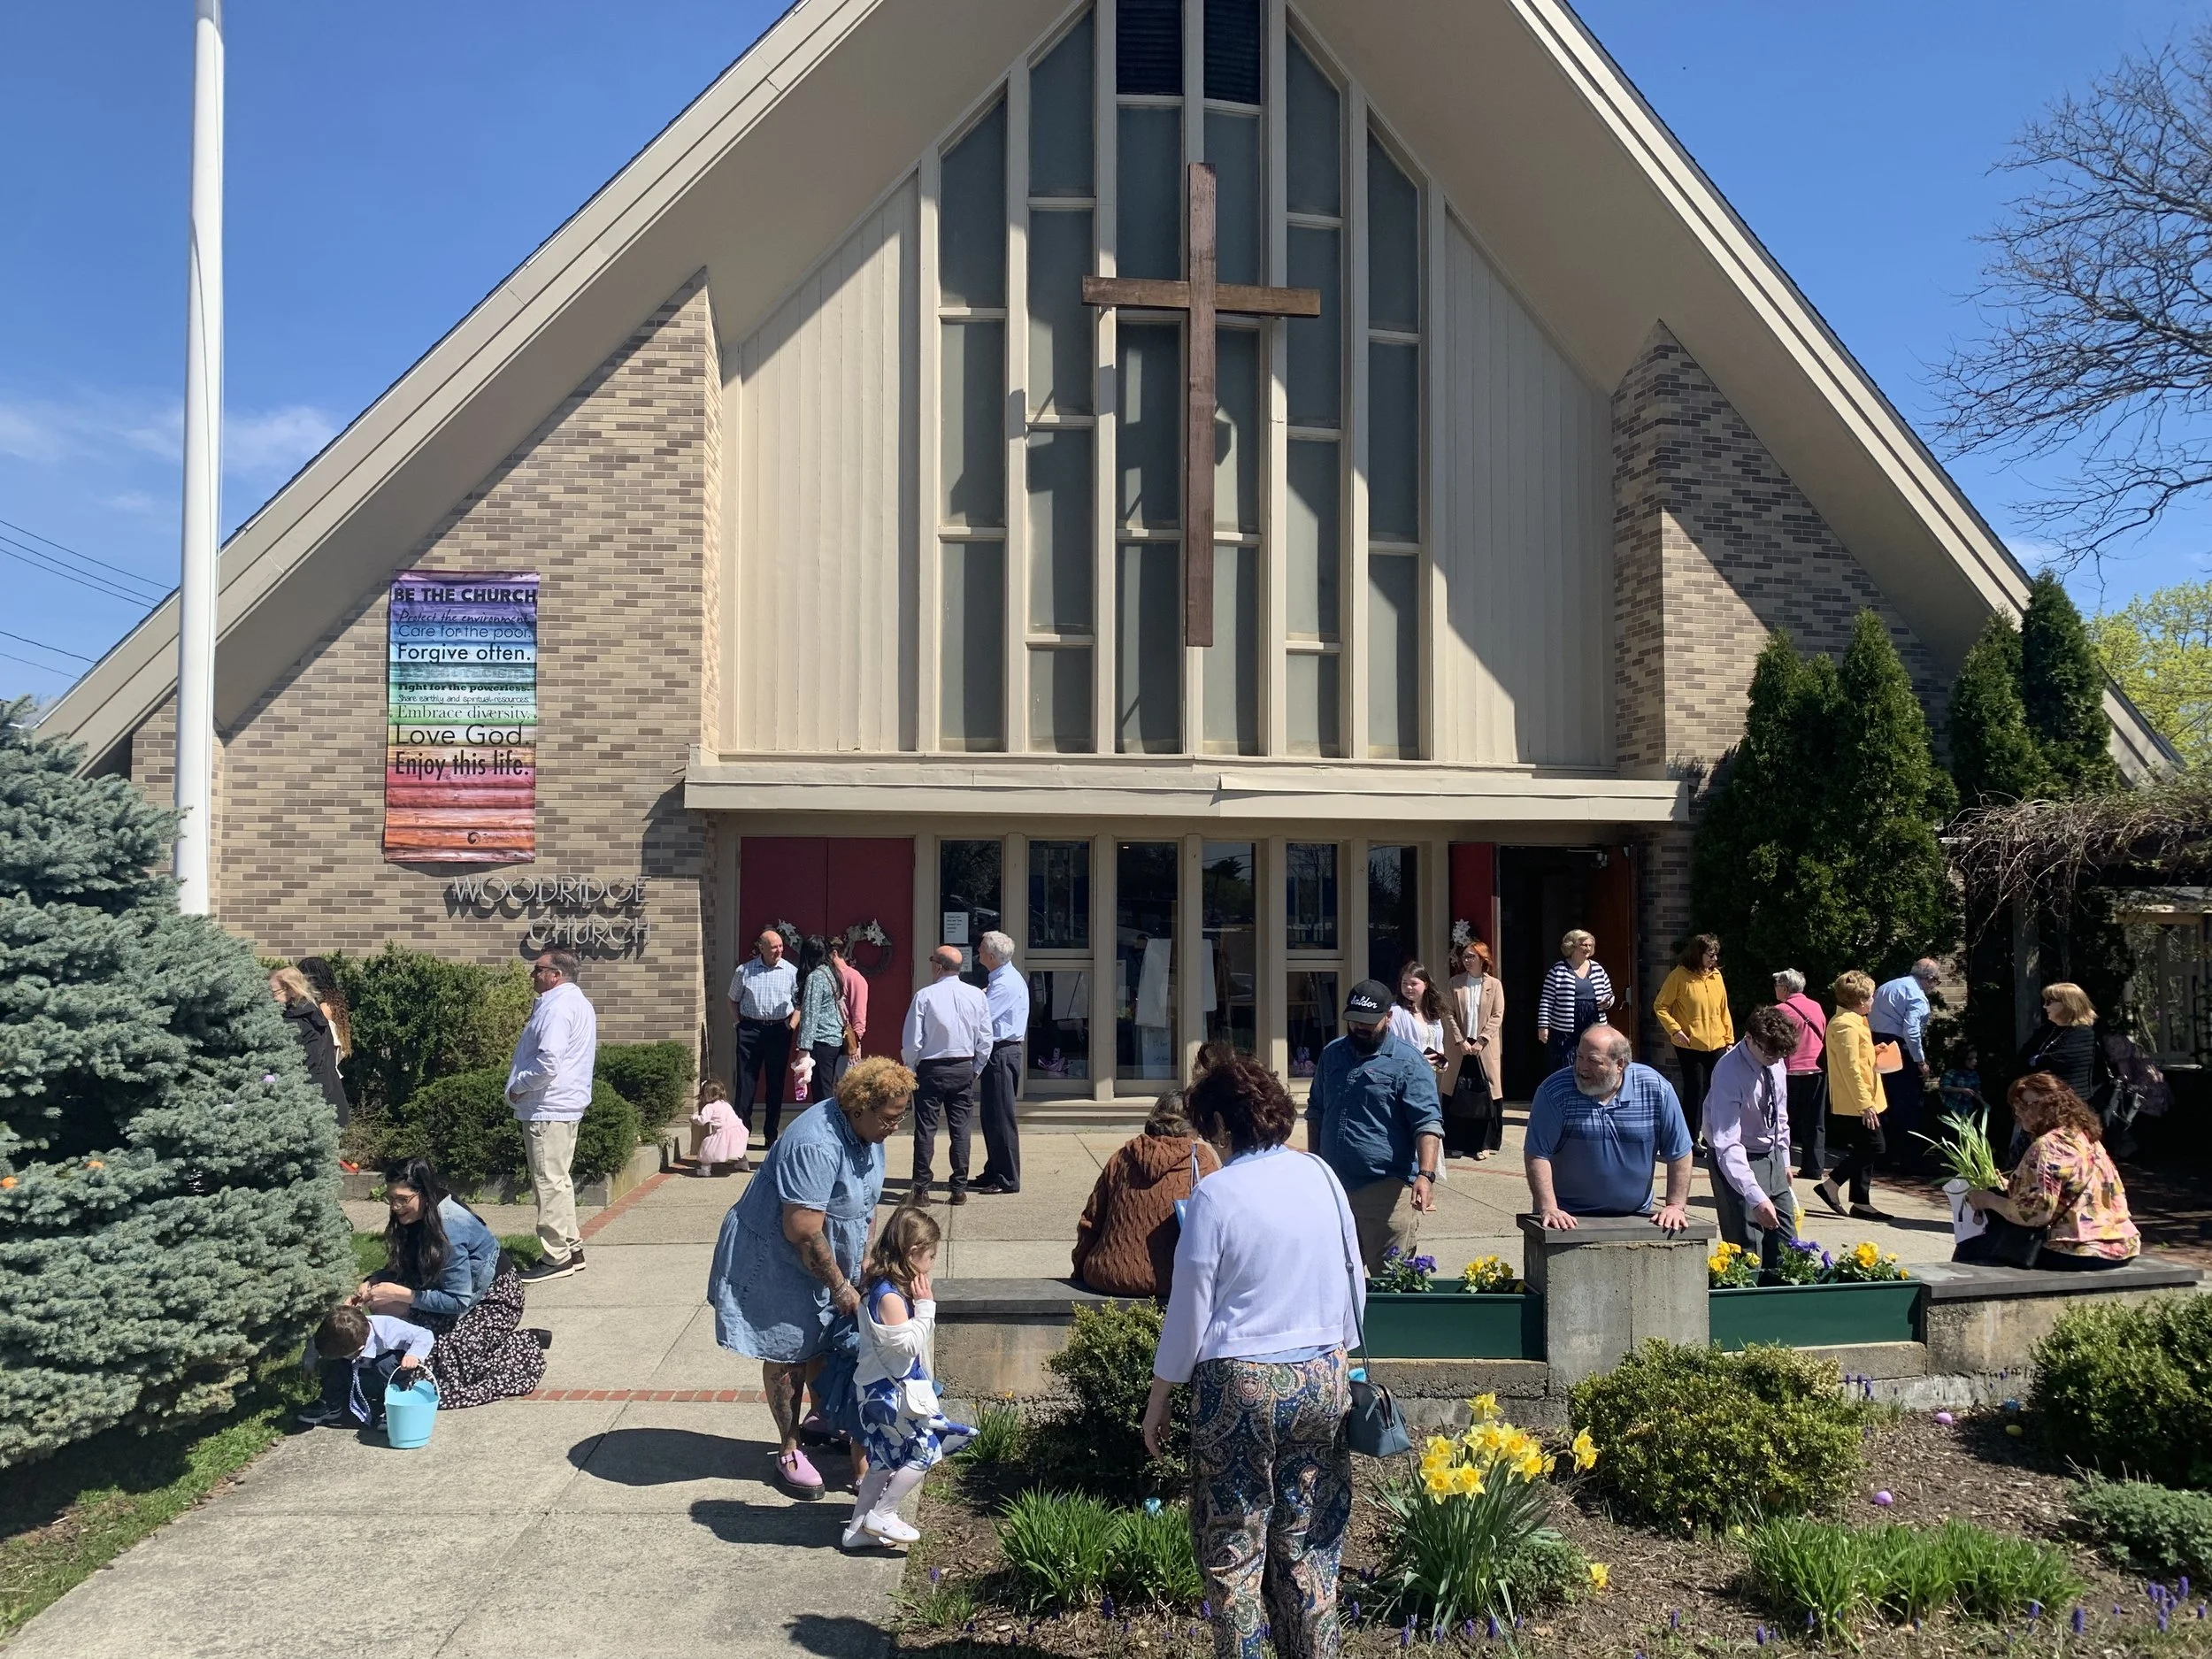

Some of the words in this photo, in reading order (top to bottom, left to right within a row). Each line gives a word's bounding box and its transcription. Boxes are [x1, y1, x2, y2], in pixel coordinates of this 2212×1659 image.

[395, 588, 415, 602] BE
[421, 588, 455, 602] THE
[461, 588, 537, 603] CHURCH
[399, 609, 436, 623] Protect
[442, 609, 457, 622] the
[398, 625, 435, 637] Care
[441, 625, 459, 637] for
[465, 626, 488, 637] the
[494, 627, 531, 640] poor.
[398, 642, 468, 663] Forgive
[476, 642, 531, 661] often.
[398, 683, 427, 692] Fight
[469, 684, 531, 693] powerless.
[419, 695, 444, 704] earthly
[397, 705, 462, 718] Embrace
[467, 705, 530, 721] diversity.
[396, 725, 456, 745] Love
[466, 724, 530, 745] God.
[396, 751, 446, 780] Enjoy
[453, 749, 486, 775] this
[494, 749, 529, 775] life.
[452, 876, 651, 902] WOODRIDGE
[530, 917, 650, 944] CHURCH
